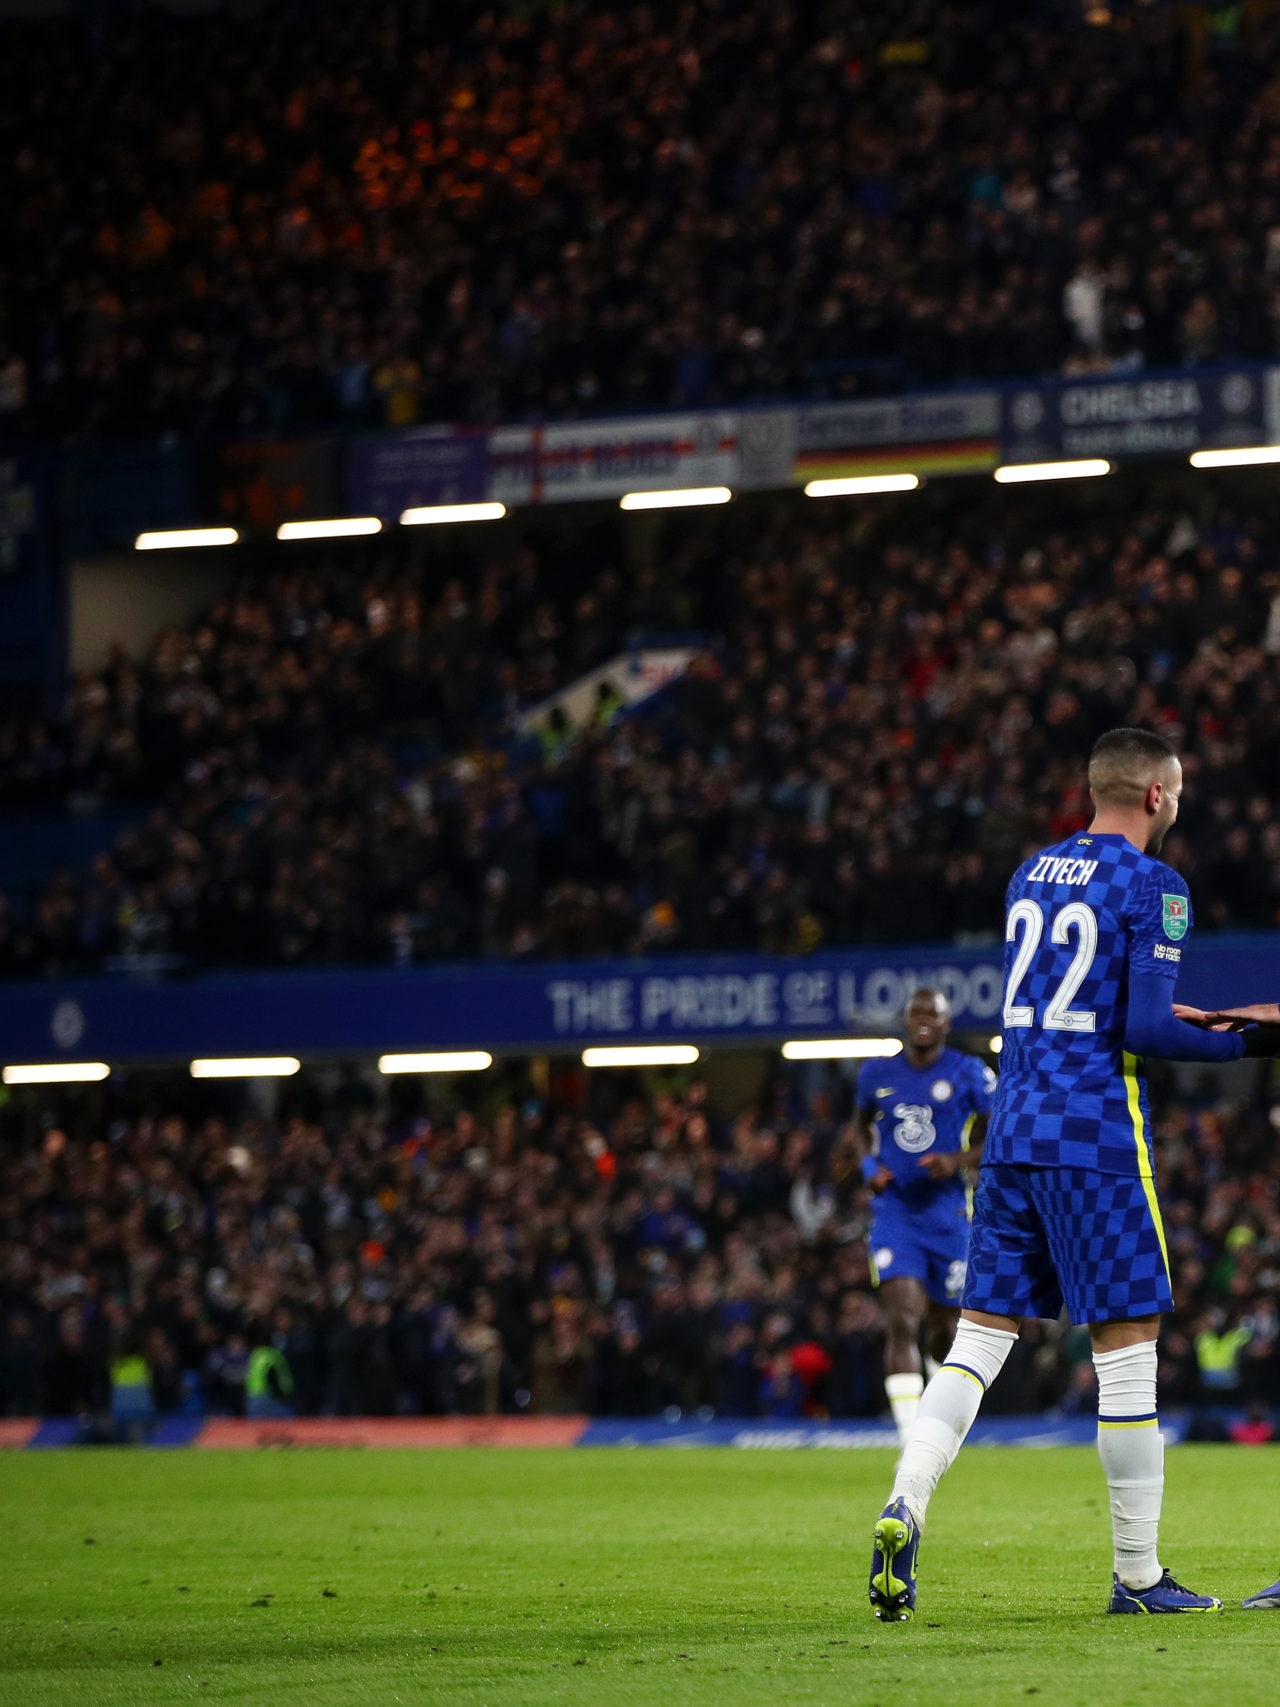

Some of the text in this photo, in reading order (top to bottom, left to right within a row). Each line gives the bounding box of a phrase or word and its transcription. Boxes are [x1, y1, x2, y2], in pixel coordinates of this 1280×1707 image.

[1027, 856, 1099, 885] ZIYECH
[1003, 898, 1098, 1032] 22
[547, 977, 633, 1033] THE
[641, 971, 779, 1030] PRIDE
